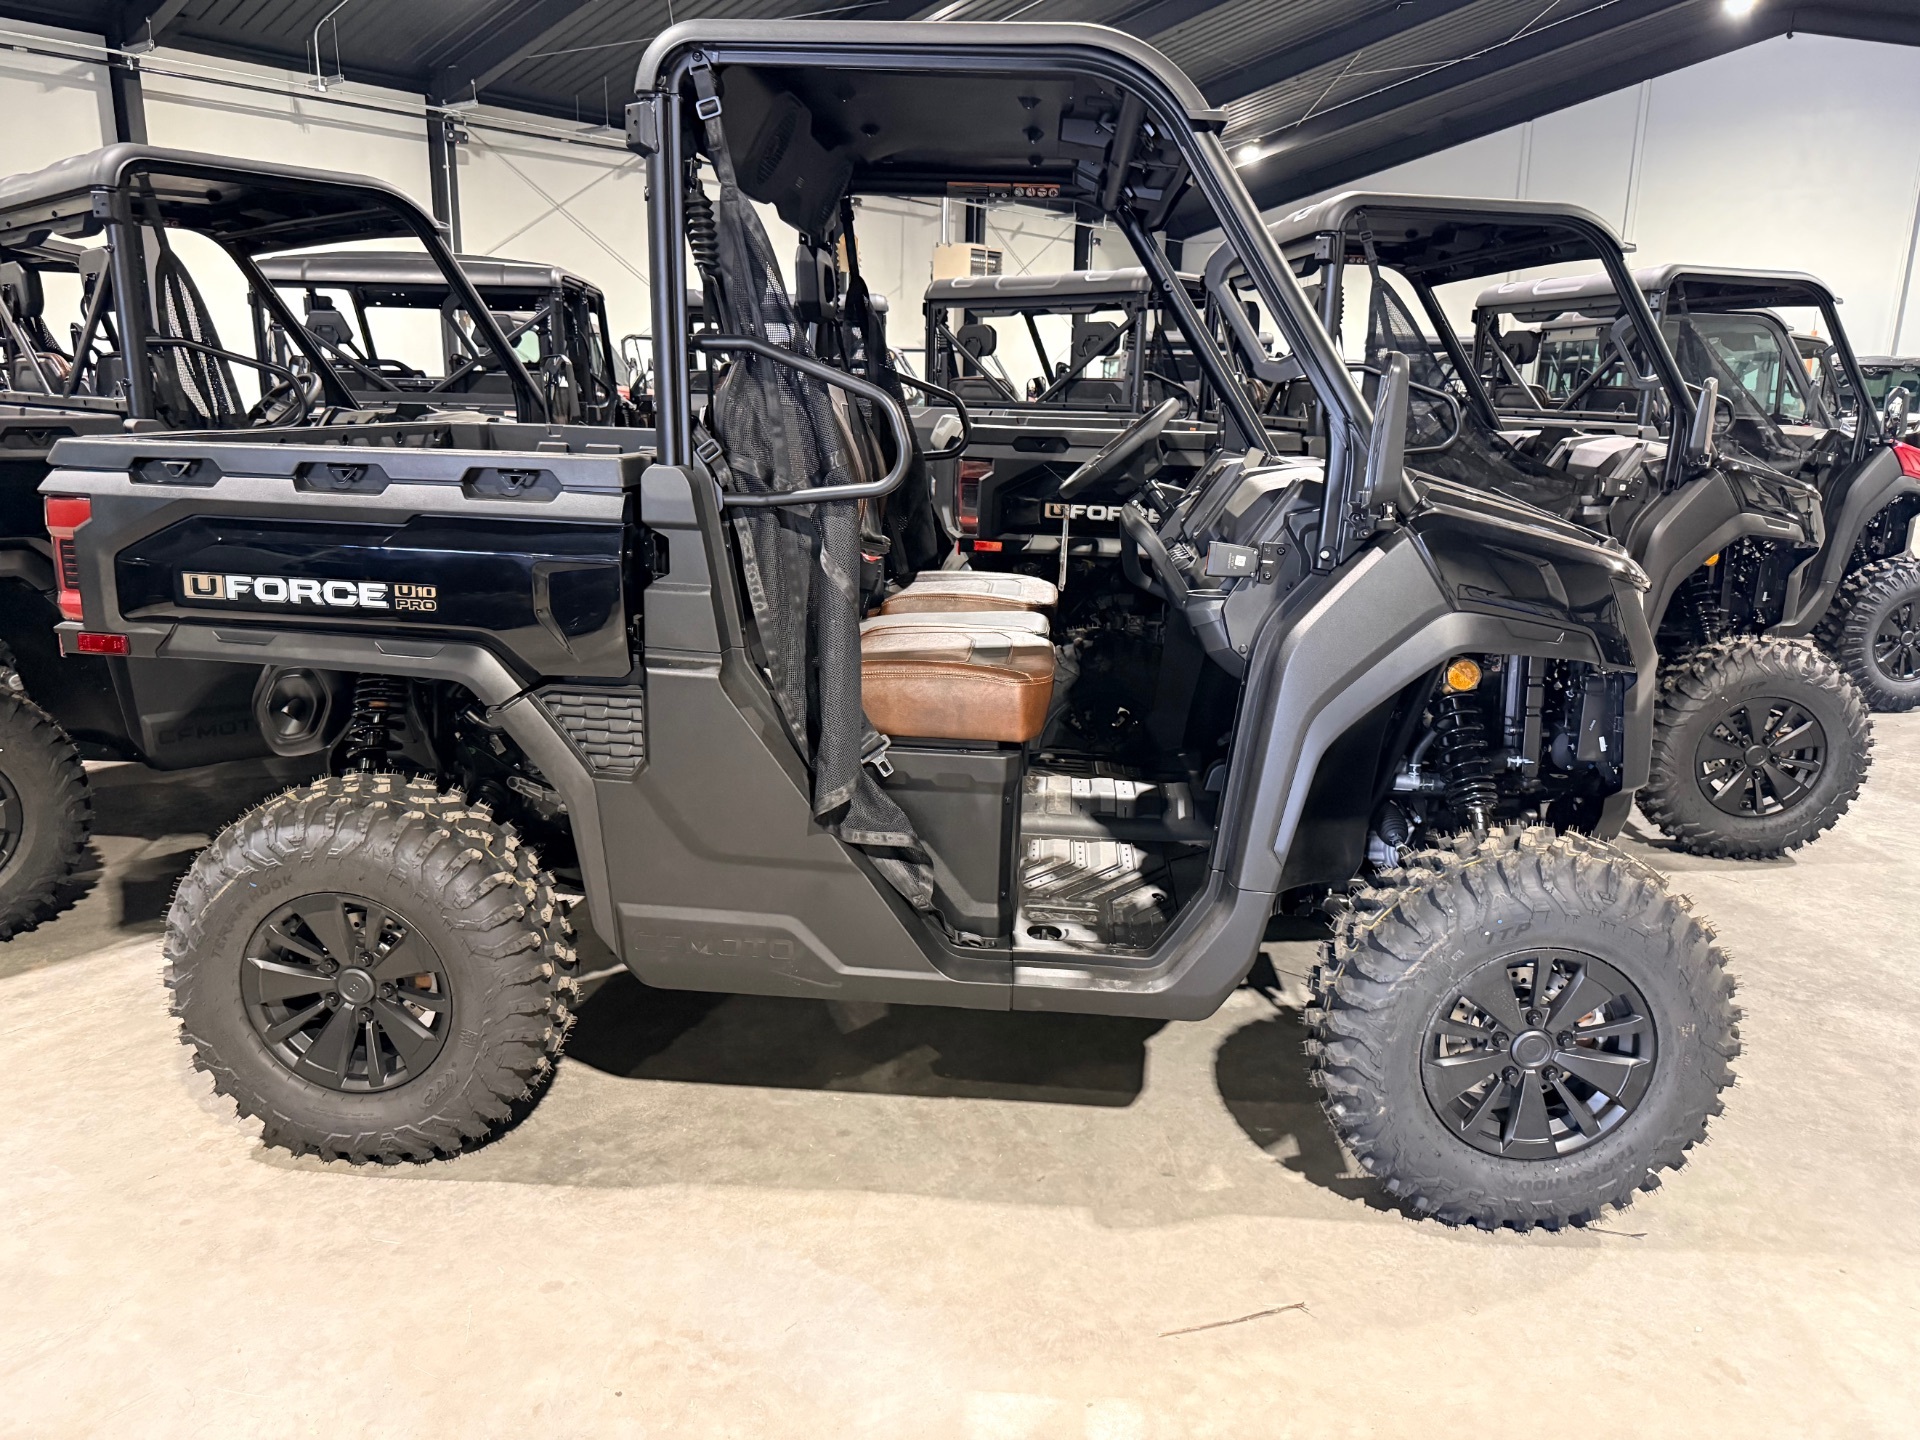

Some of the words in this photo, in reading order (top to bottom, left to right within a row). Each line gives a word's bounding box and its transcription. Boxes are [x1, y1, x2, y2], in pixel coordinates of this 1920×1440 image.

[182, 572, 389, 609] UFORCE
[394, 584, 437, 598] U10
[395, 598, 437, 612] PRO
